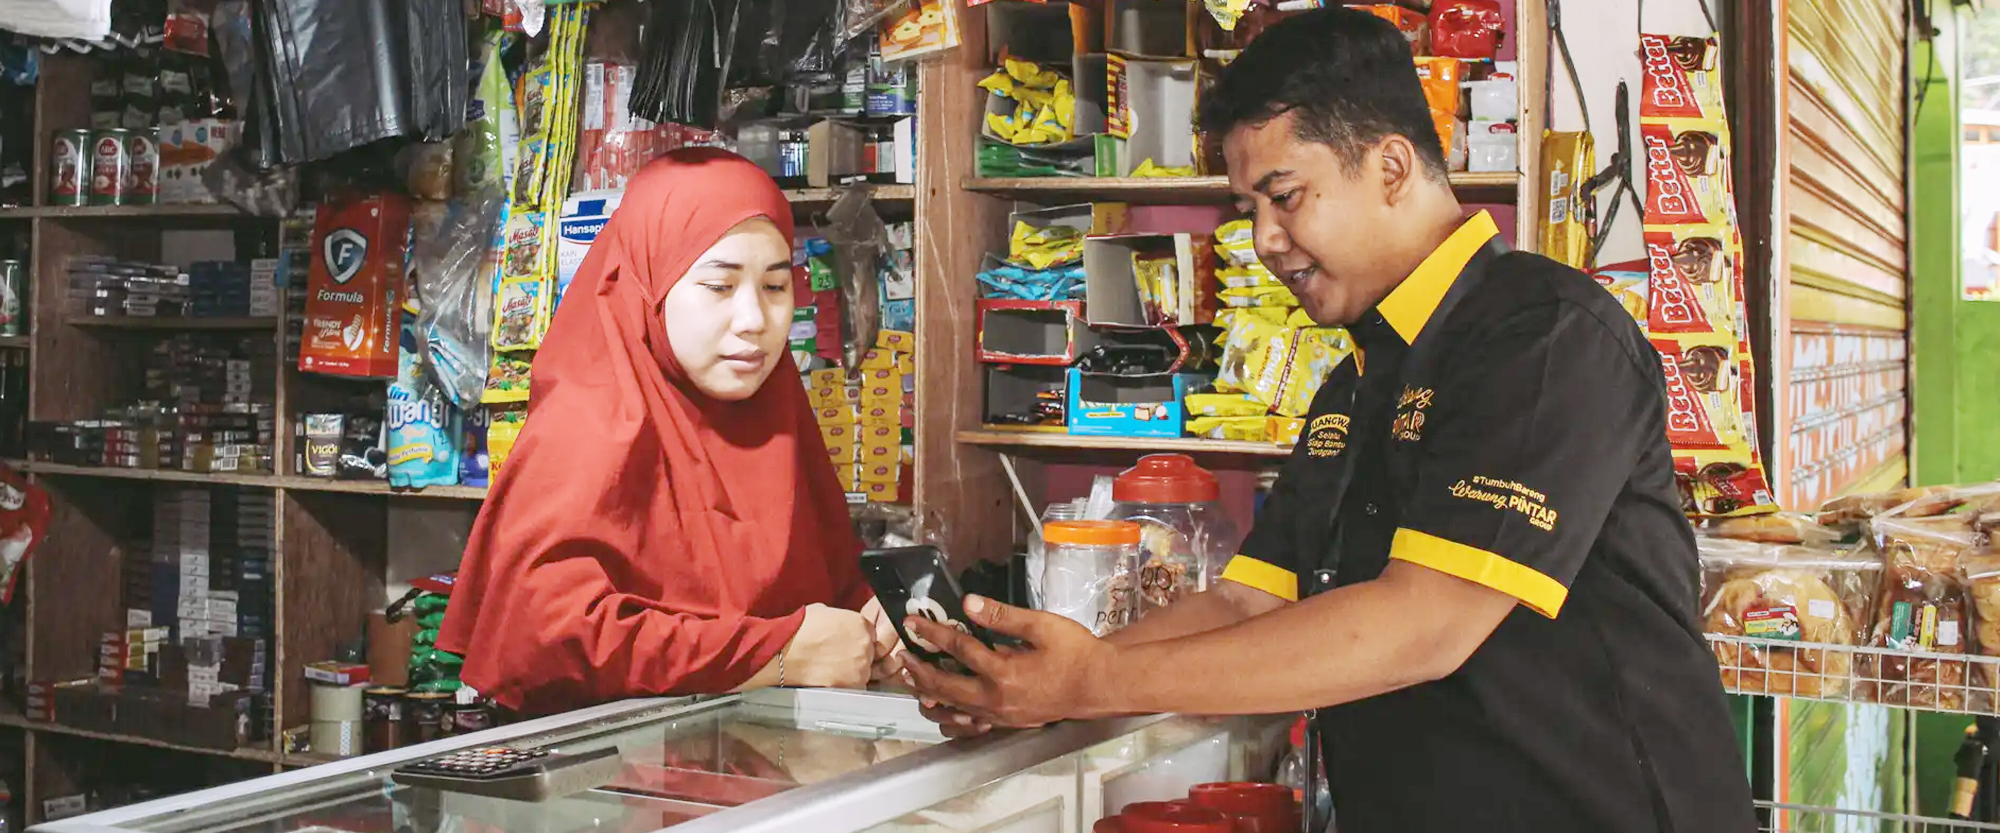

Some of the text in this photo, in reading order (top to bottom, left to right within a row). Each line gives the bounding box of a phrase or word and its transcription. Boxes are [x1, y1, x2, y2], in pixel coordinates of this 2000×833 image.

[1642, 36, 1684, 107] Better
[1645, 135, 1687, 214] Better
[338, 243, 353, 265] F
[317, 289, 364, 303] Formula
[1648, 243, 1692, 323] Better
[1657, 351, 1698, 431] Better
[1448, 480, 1557, 525] Warung PINTAR
[1472, 476, 1546, 503] #TumbuhBareng
[1529, 517, 1553, 531] GROUP
